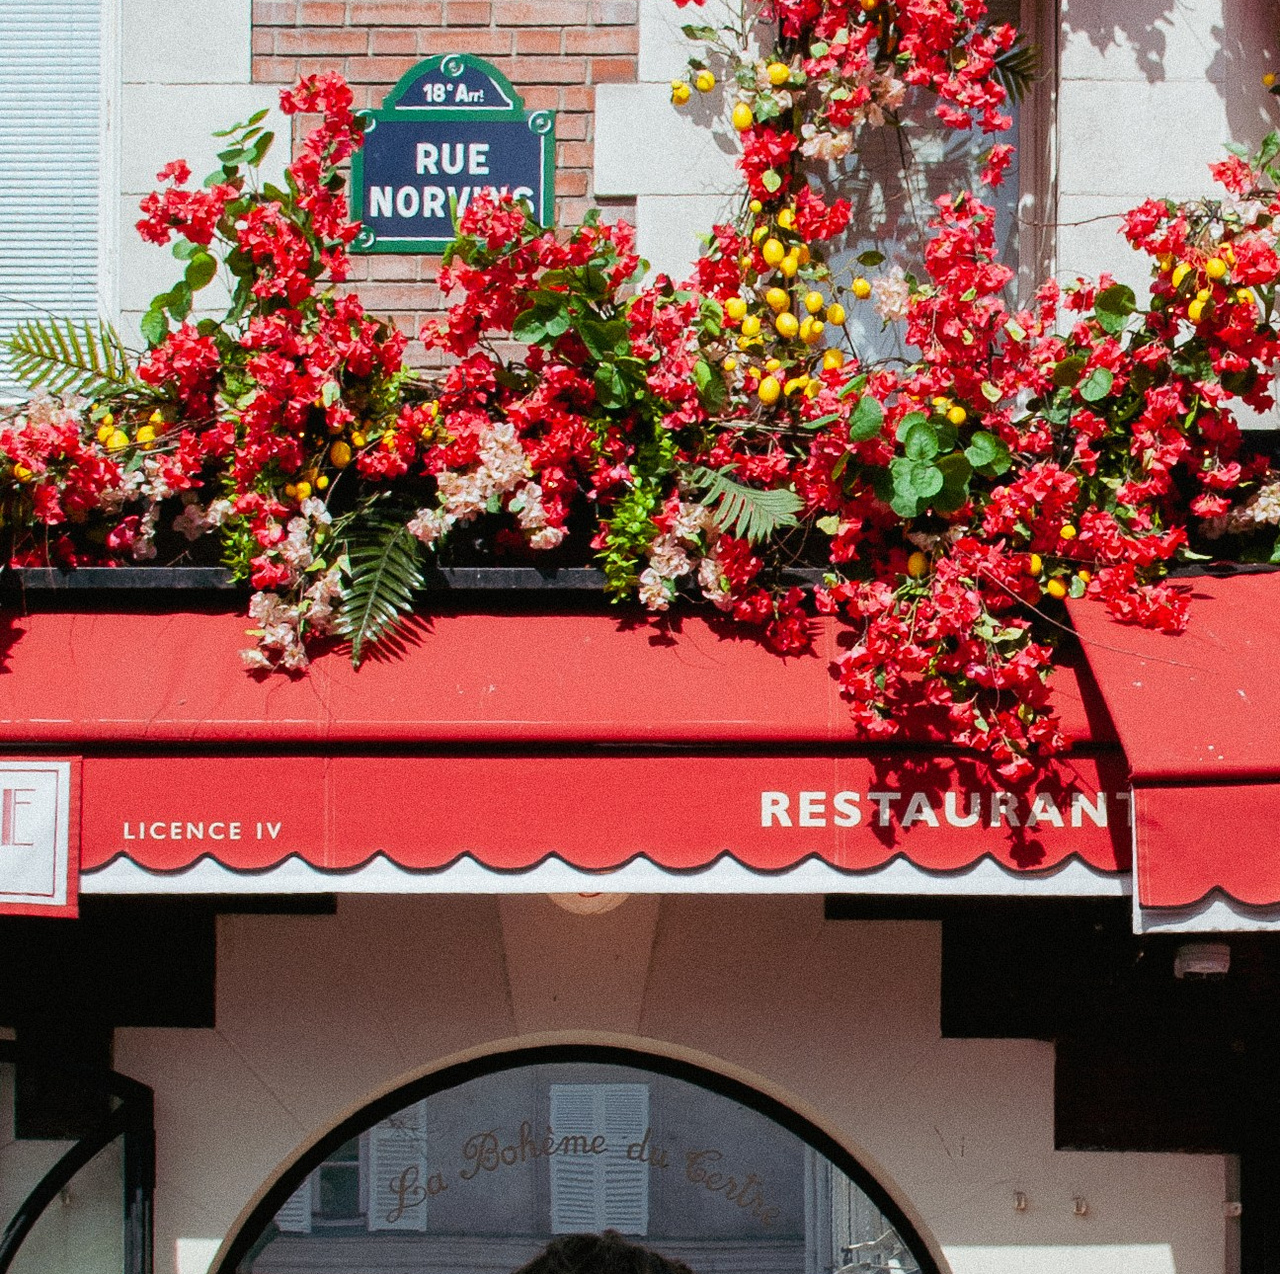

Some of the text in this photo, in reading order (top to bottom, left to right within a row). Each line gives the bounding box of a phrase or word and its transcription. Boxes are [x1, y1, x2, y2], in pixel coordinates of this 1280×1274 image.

[416, 143, 490, 175] RUE
[124, 822, 282, 840] LICENCE IV
[386, 1165, 448, 1223] La
[460, 1119, 607, 1180] Bohème
[627, 1127, 670, 1169] du
